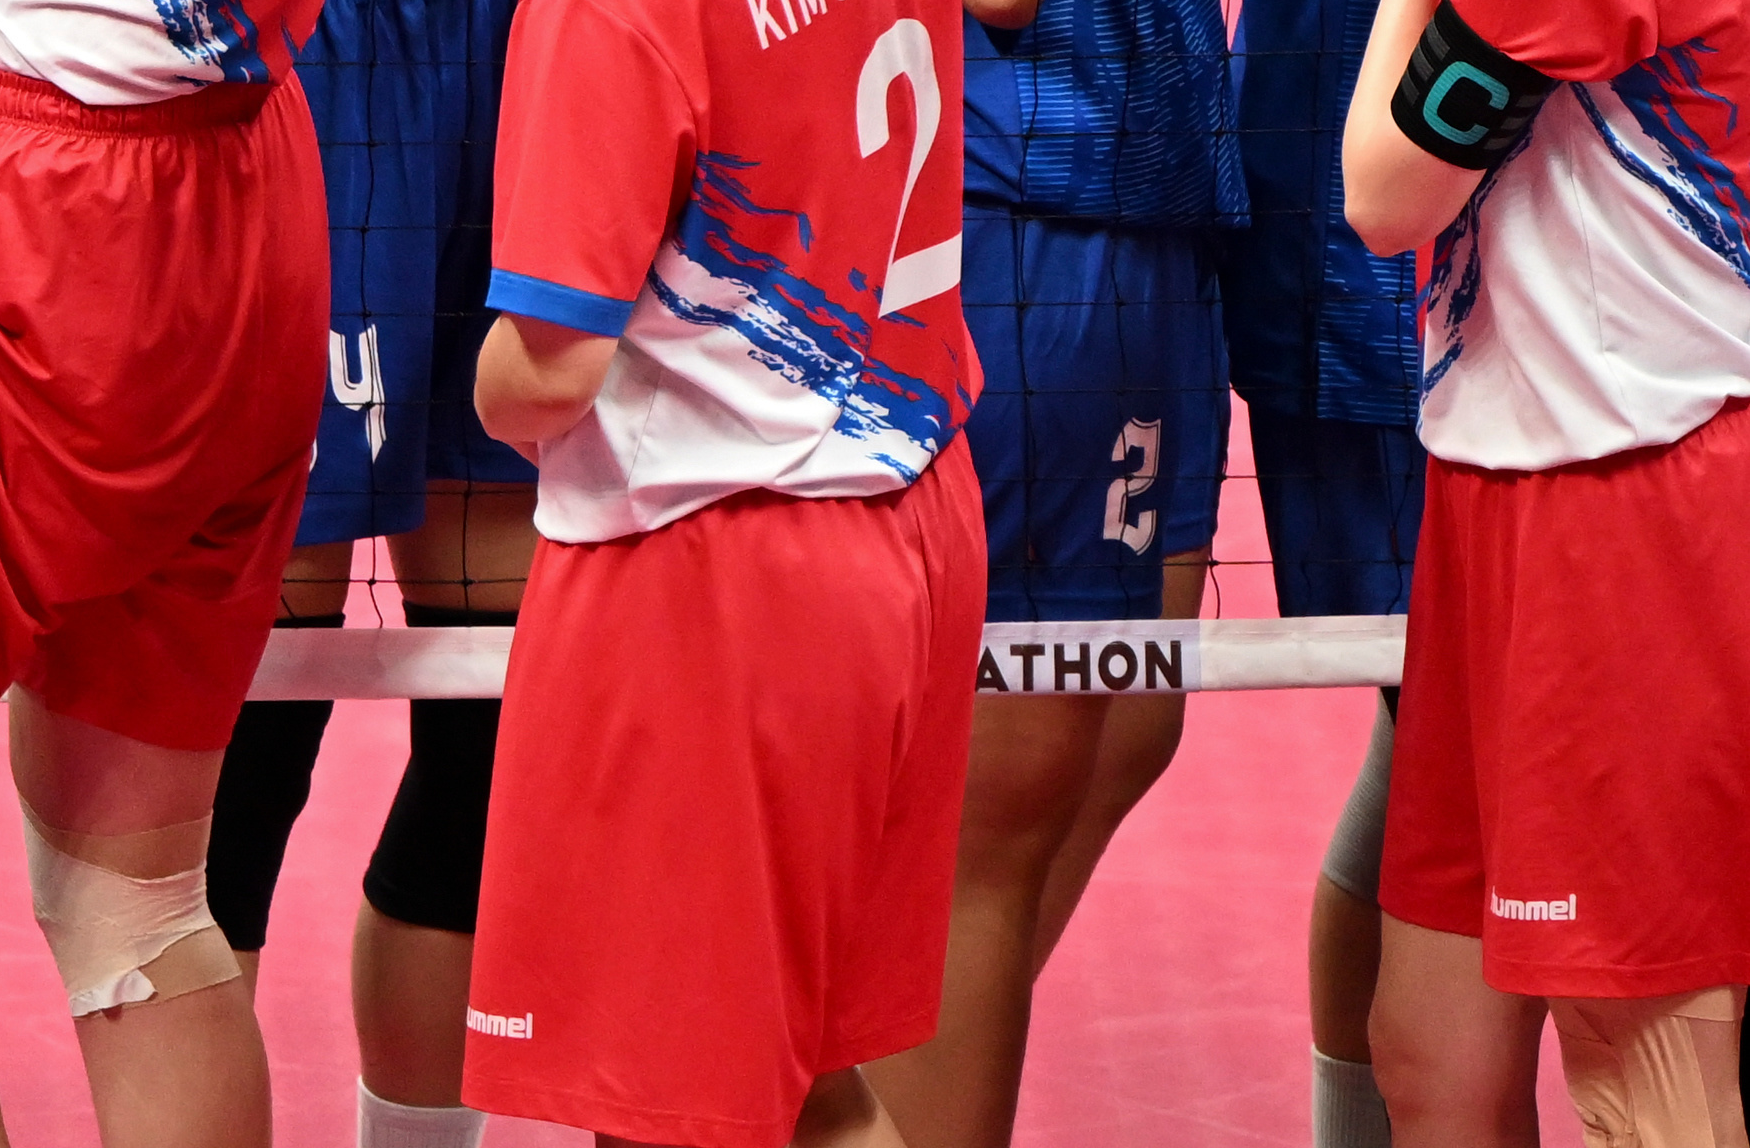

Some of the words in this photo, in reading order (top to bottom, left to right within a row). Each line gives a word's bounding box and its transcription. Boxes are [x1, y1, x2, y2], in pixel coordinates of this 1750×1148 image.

[1422, 60, 1510, 145] C
[856, 18, 963, 319] 2
[1103, 416, 1162, 556] 2
[1490, 885, 1577, 921] ummel
